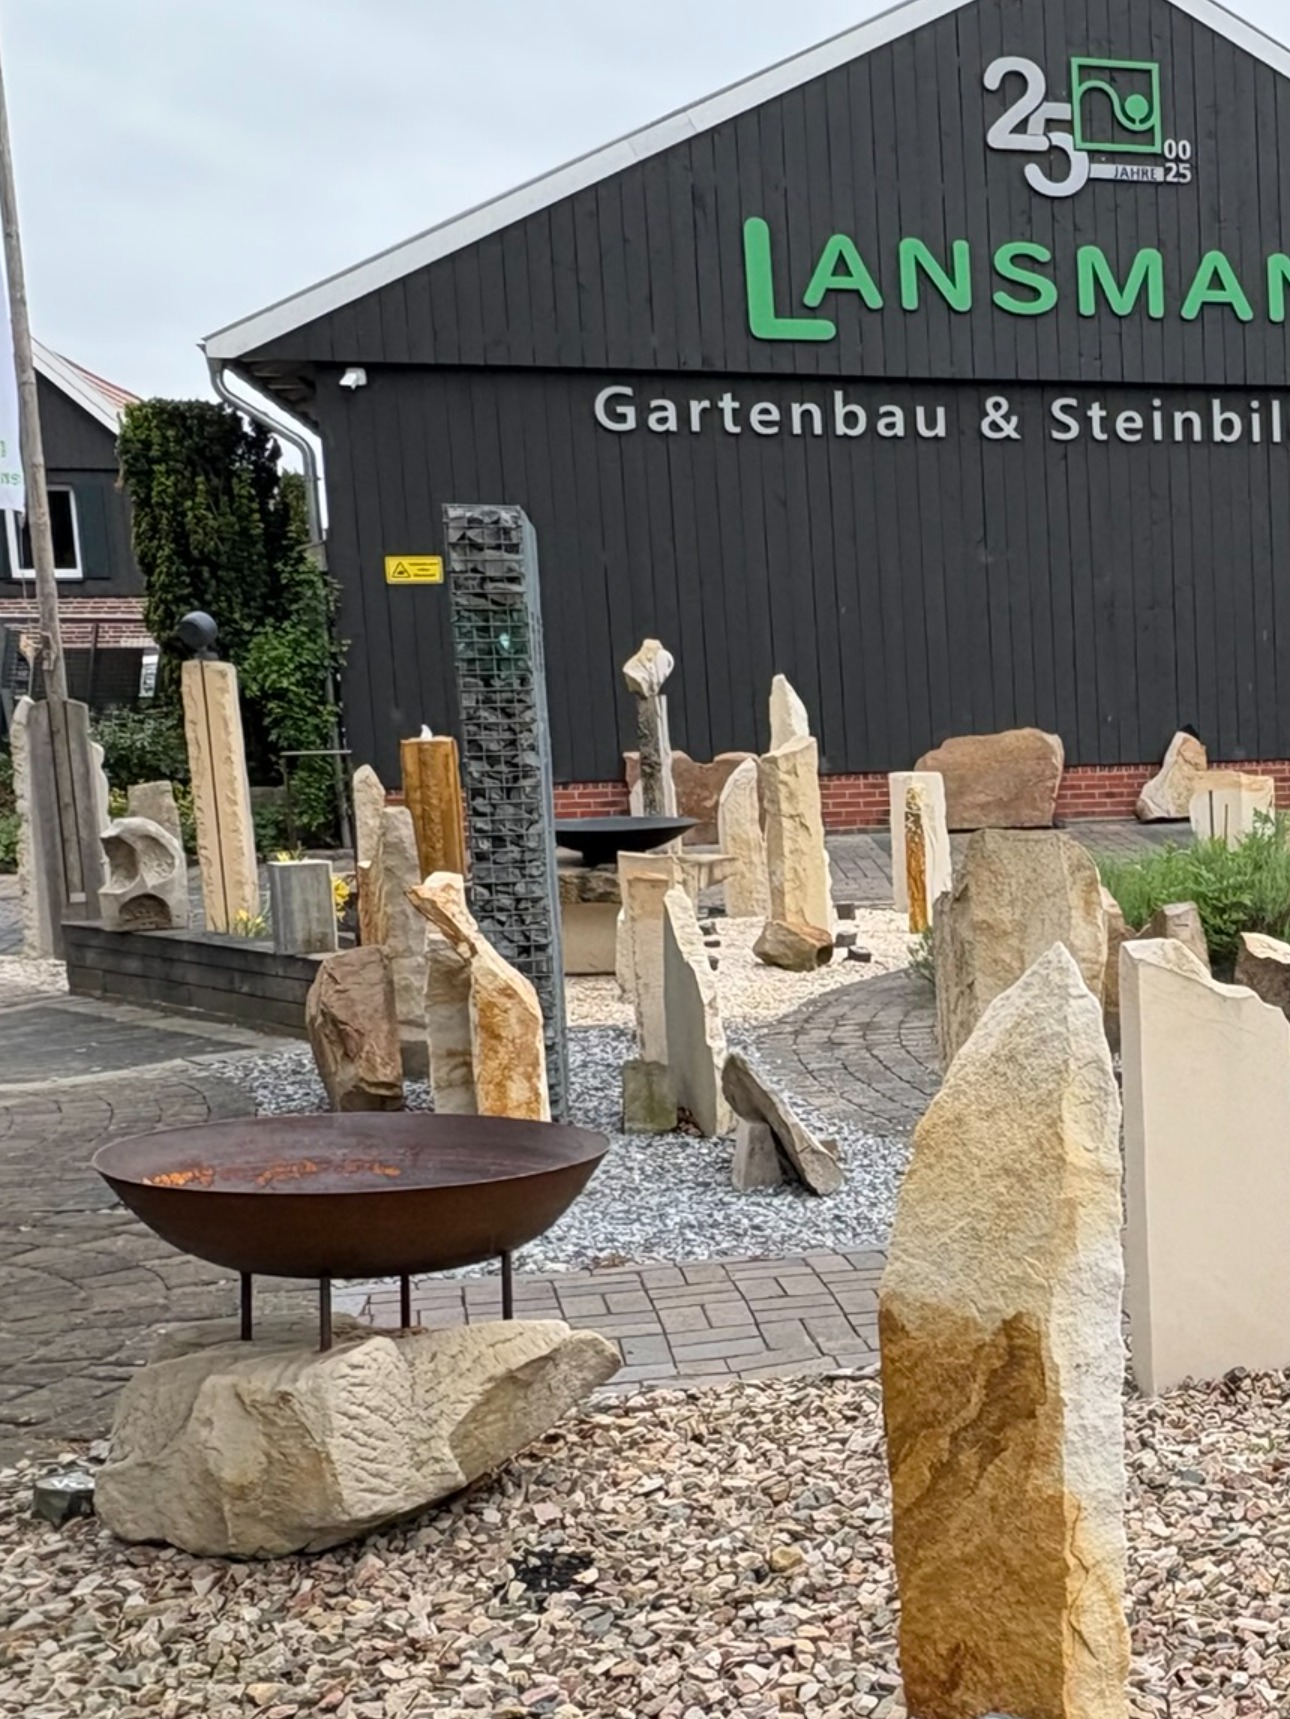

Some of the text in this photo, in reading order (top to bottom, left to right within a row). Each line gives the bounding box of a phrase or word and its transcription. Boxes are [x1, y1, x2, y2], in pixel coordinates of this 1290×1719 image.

[983, 56, 1090, 198] 25
[1163, 138, 1192, 160] 00
[1112, 165, 1158, 181] JAHRE
[1164, 162, 1192, 183] 25
[594, 385, 947, 438] Gartenbau
[980, 395, 1021, 440] &
